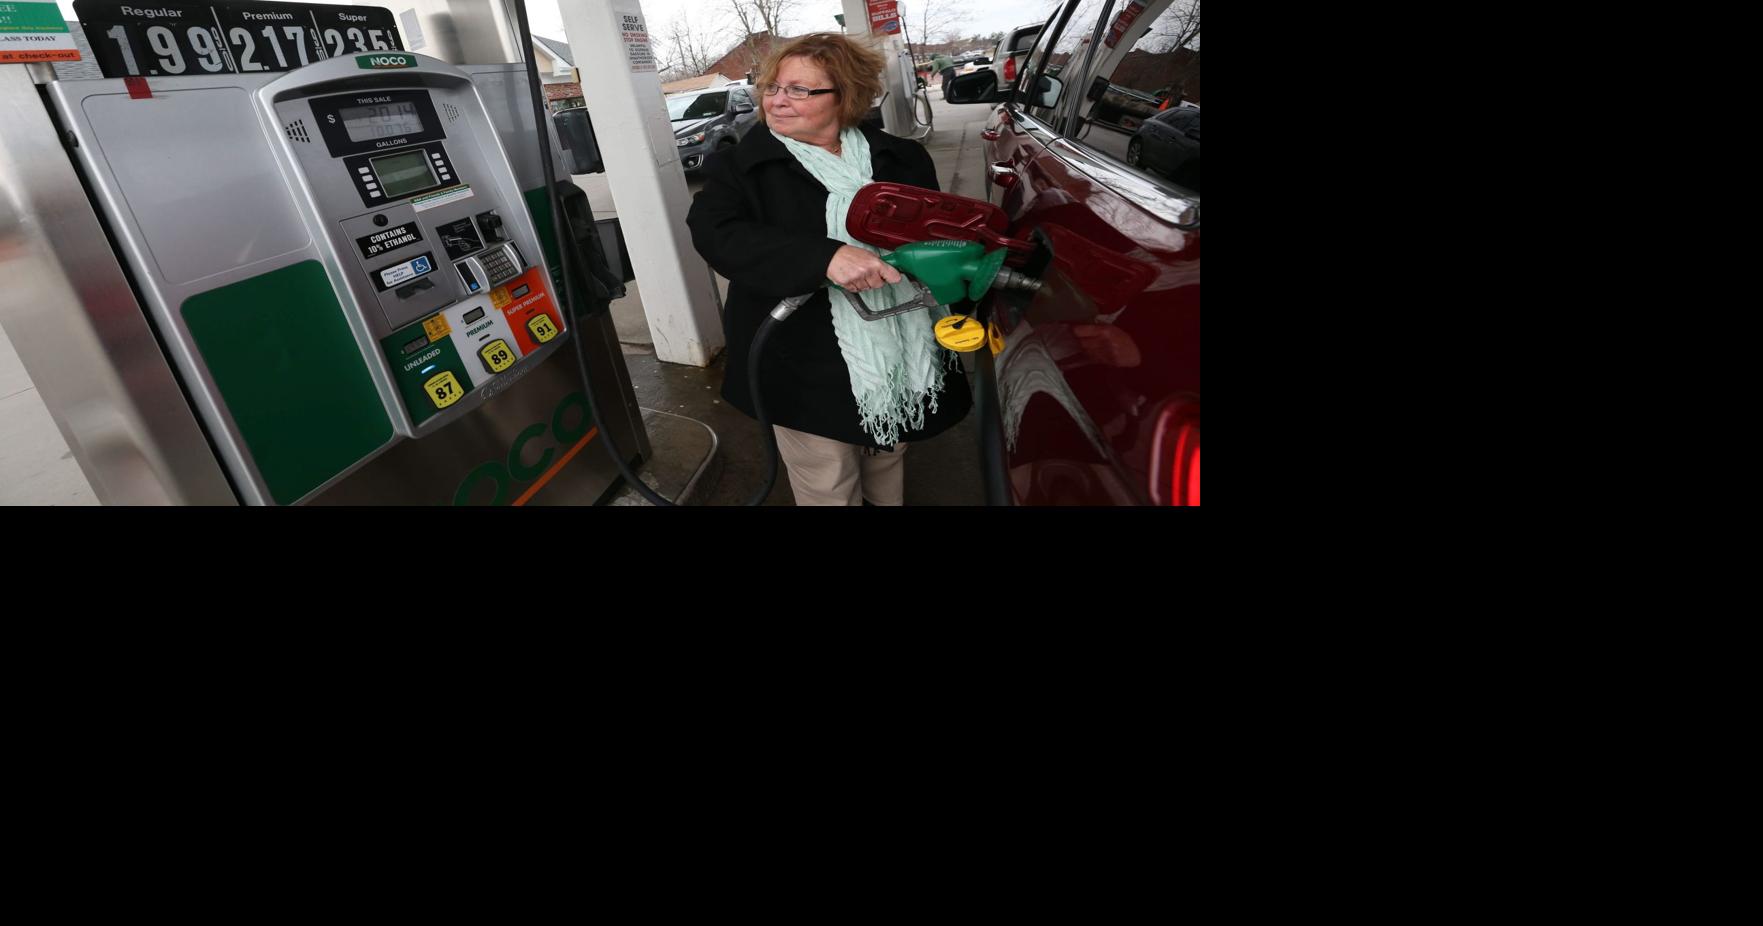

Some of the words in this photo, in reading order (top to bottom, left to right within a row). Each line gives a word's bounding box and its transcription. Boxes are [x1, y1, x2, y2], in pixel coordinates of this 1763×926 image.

[120, 5, 183, 19] Regular
[242, 11, 294, 20] Premium
[338, 12, 368, 23] Super
[623, 15, 639, 24] SELF
[622, 23, 644, 32] SERVE
[369, 56, 407, 67] NOCO
[356, 97, 373, 105] THIS
[374, 95, 392, 103] SALE
[326, 114, 336, 124] $
[376, 138, 408, 148] GALLONS
[370, 226, 407, 243] CONTAINS
[367, 244, 384, 254] 10%
[384, 233, 417, 249] ETHANOL
[506, 303, 523, 315] SUPER
[522, 292, 545, 308] PREMIUM
[466, 319, 494, 338] PREMIUM
[536, 322, 552, 337] 91
[404, 348, 441, 372] UNLEADED
[491, 349, 509, 366] 89
[435, 381, 454, 400] 87
[446, 391, 593, 506] OCO
